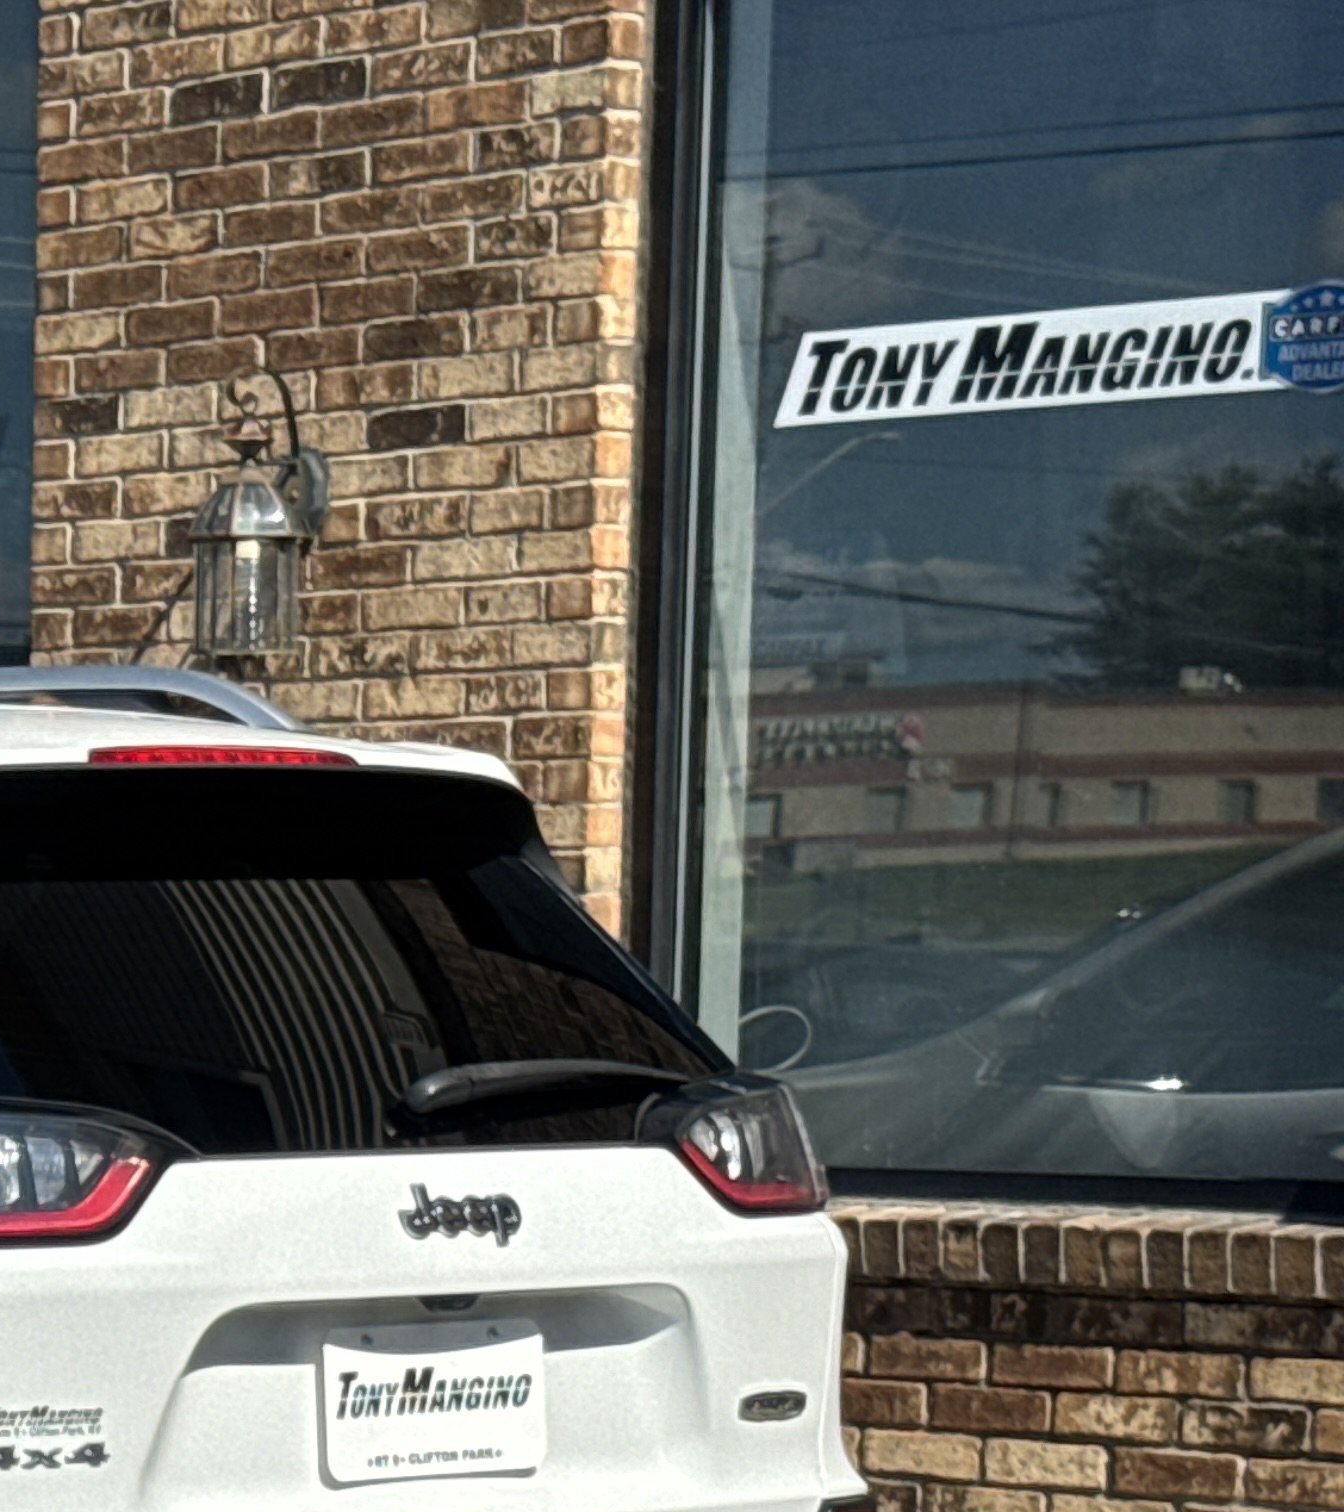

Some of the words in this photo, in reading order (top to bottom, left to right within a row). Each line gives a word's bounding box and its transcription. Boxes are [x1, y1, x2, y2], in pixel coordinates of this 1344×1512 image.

[1274, 316, 1344, 337] CARF
[1277, 341, 1344, 362] ADVANTA
[798, 338, 960, 417] TONY
[1292, 360, 1344, 381] DEALE
[397, 1182, 522, 1248] Jeep
